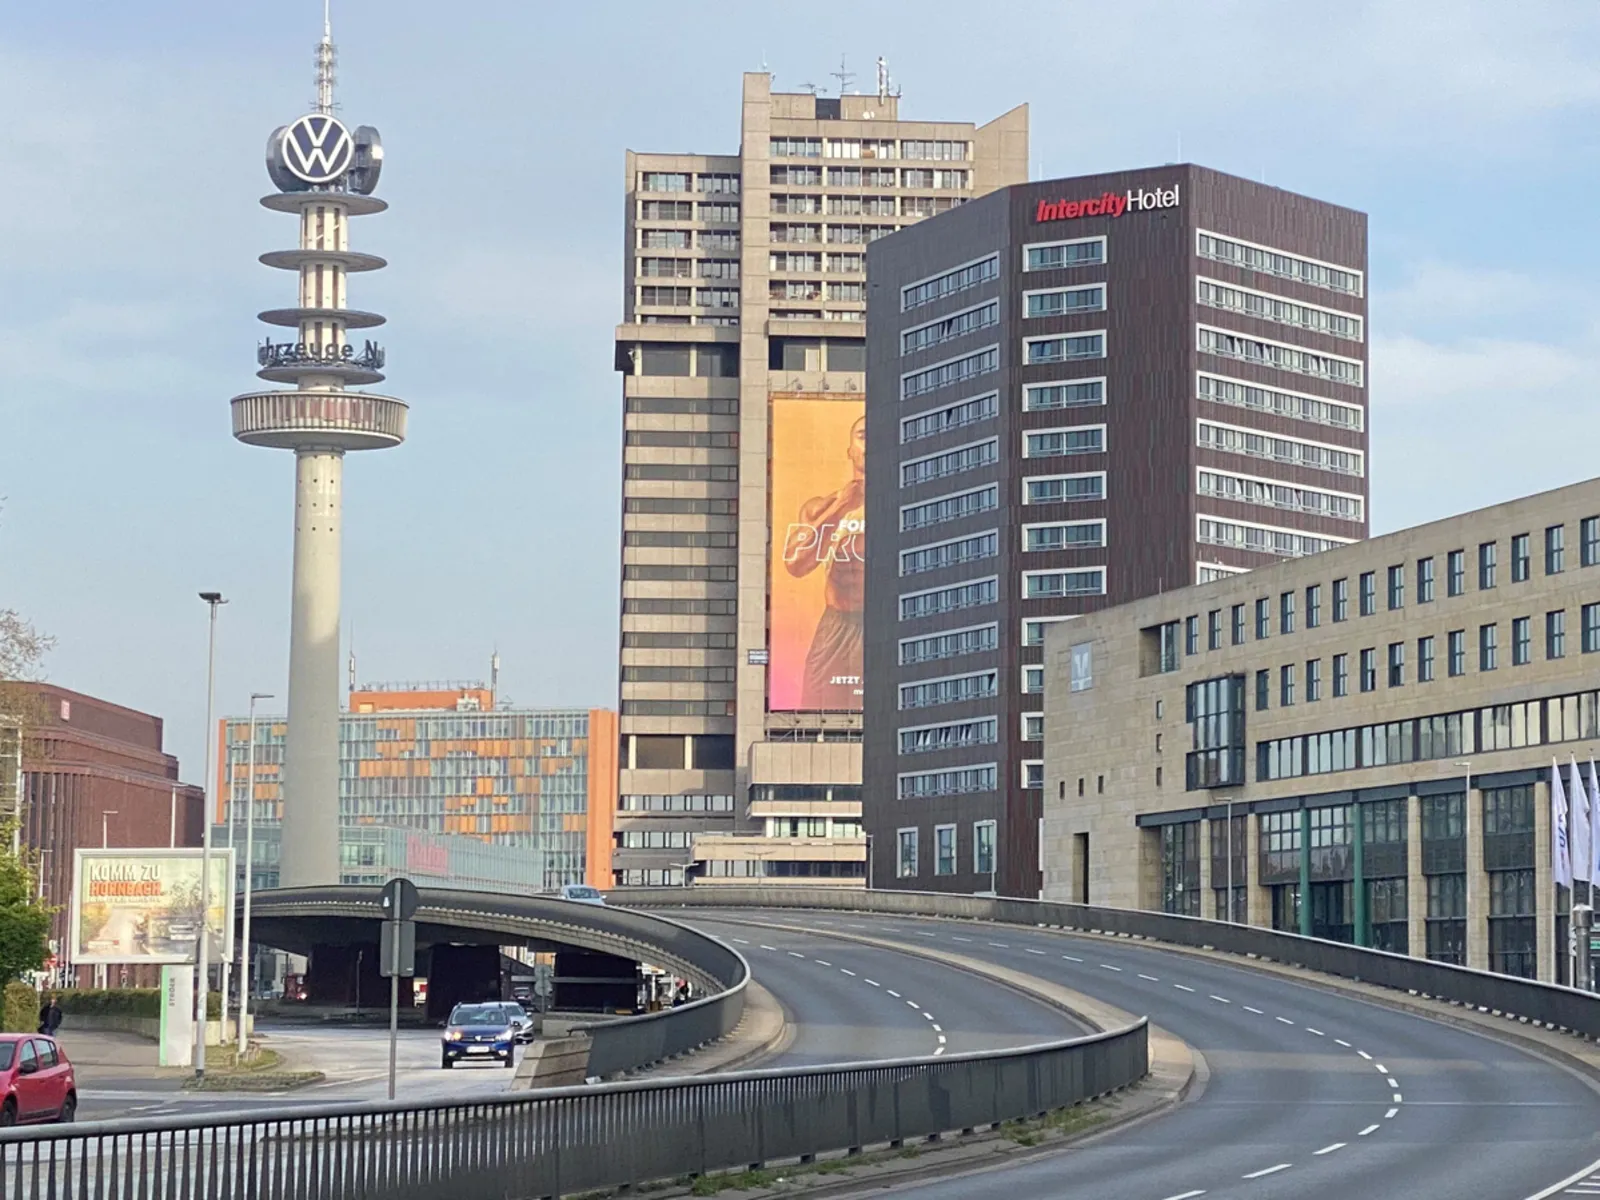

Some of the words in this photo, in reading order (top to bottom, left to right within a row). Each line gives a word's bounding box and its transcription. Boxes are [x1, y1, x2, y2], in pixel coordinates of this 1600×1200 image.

[1036, 184, 1179, 222] IntercityHotel
[829, 675, 860, 685] JETZT
[90, 864, 137, 881] KOMM
[140, 864, 161, 881] ZU
